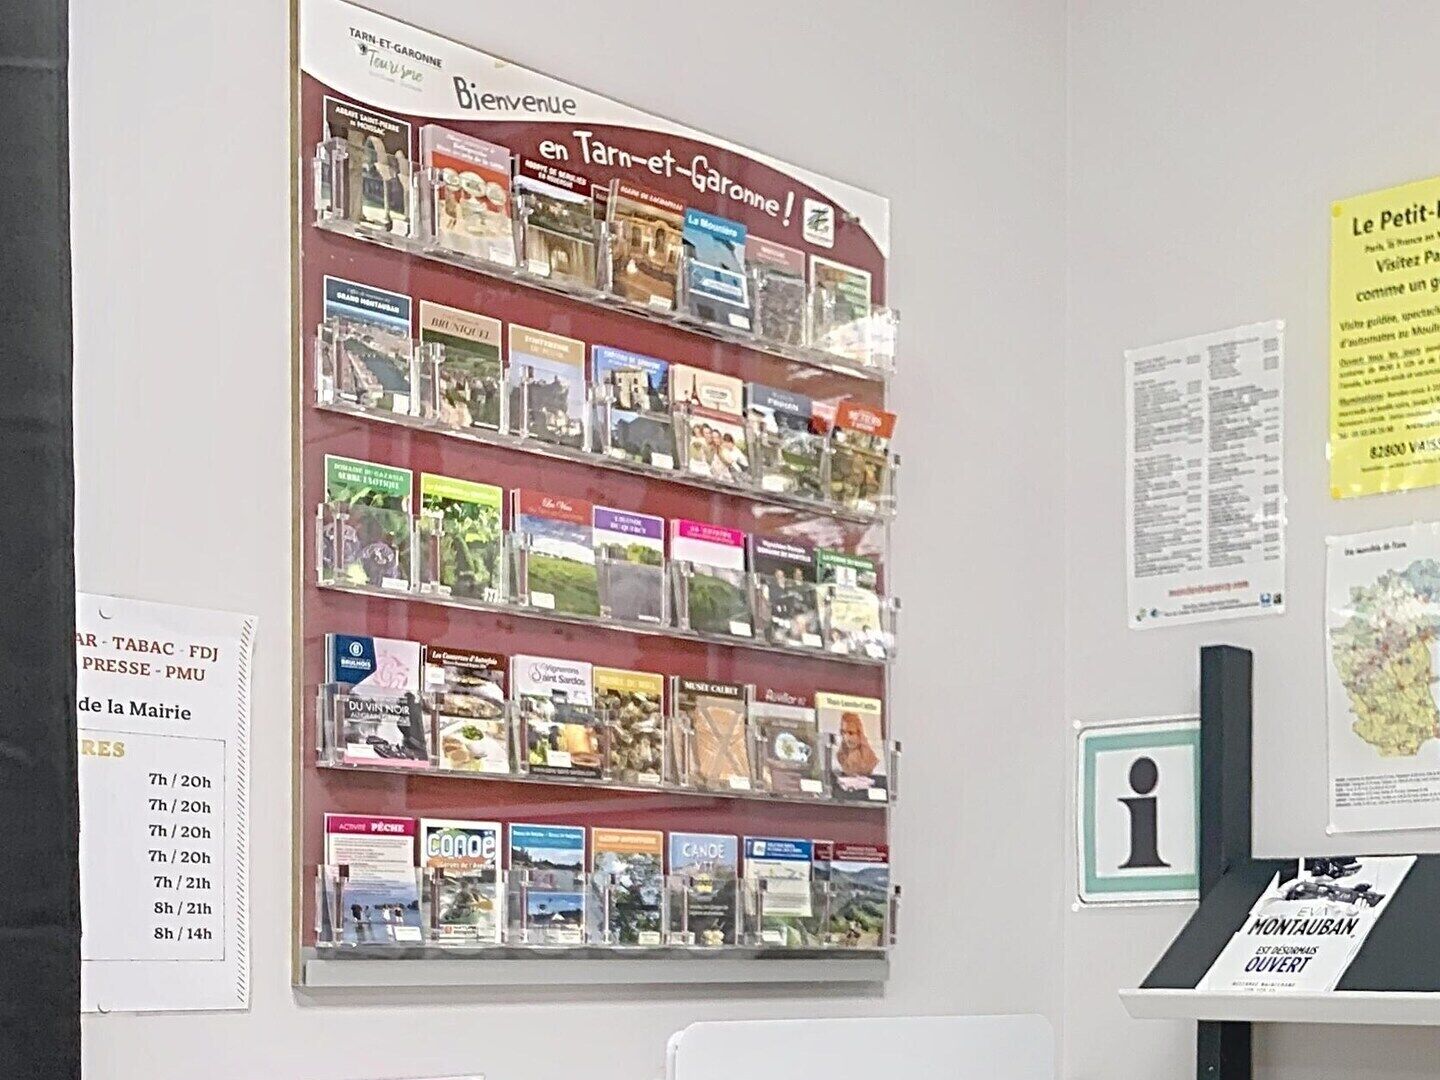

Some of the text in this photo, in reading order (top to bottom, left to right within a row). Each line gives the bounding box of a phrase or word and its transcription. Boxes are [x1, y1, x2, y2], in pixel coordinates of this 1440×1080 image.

[350, 27, 442, 68] TARN-ET-GARONNE
[453, 76, 576, 115] Bienvenue
[540, 140, 568, 160] en
[1353, 217, 1372, 236] Le
[1376, 253, 1420, 273] Visitez
[1356, 281, 1406, 302] comme
[1410, 279, 1426, 292] un
[113, 637, 173, 656] TABAC
[189, 645, 218, 662] FDJ
[83, 658, 205, 682] PRESSE PMU
[78, 698, 191, 720] de la Mairie
[81, 739, 125, 757] RES
[149, 773, 211, 789] 7h 20h
[149, 799, 211, 814] 7h 20h
[149, 824, 211, 840] 7h 20h
[371, 821, 404, 832] PÊCHE
[149, 850, 211, 865] 7h 20h
[682, 843, 725, 858] CANOE
[154, 876, 211, 890] 7h 21h
[154, 901, 212, 915] 8h 21h
[154, 927, 212, 940] 8h 14h
[1245, 957, 1313, 972] OUVERT
